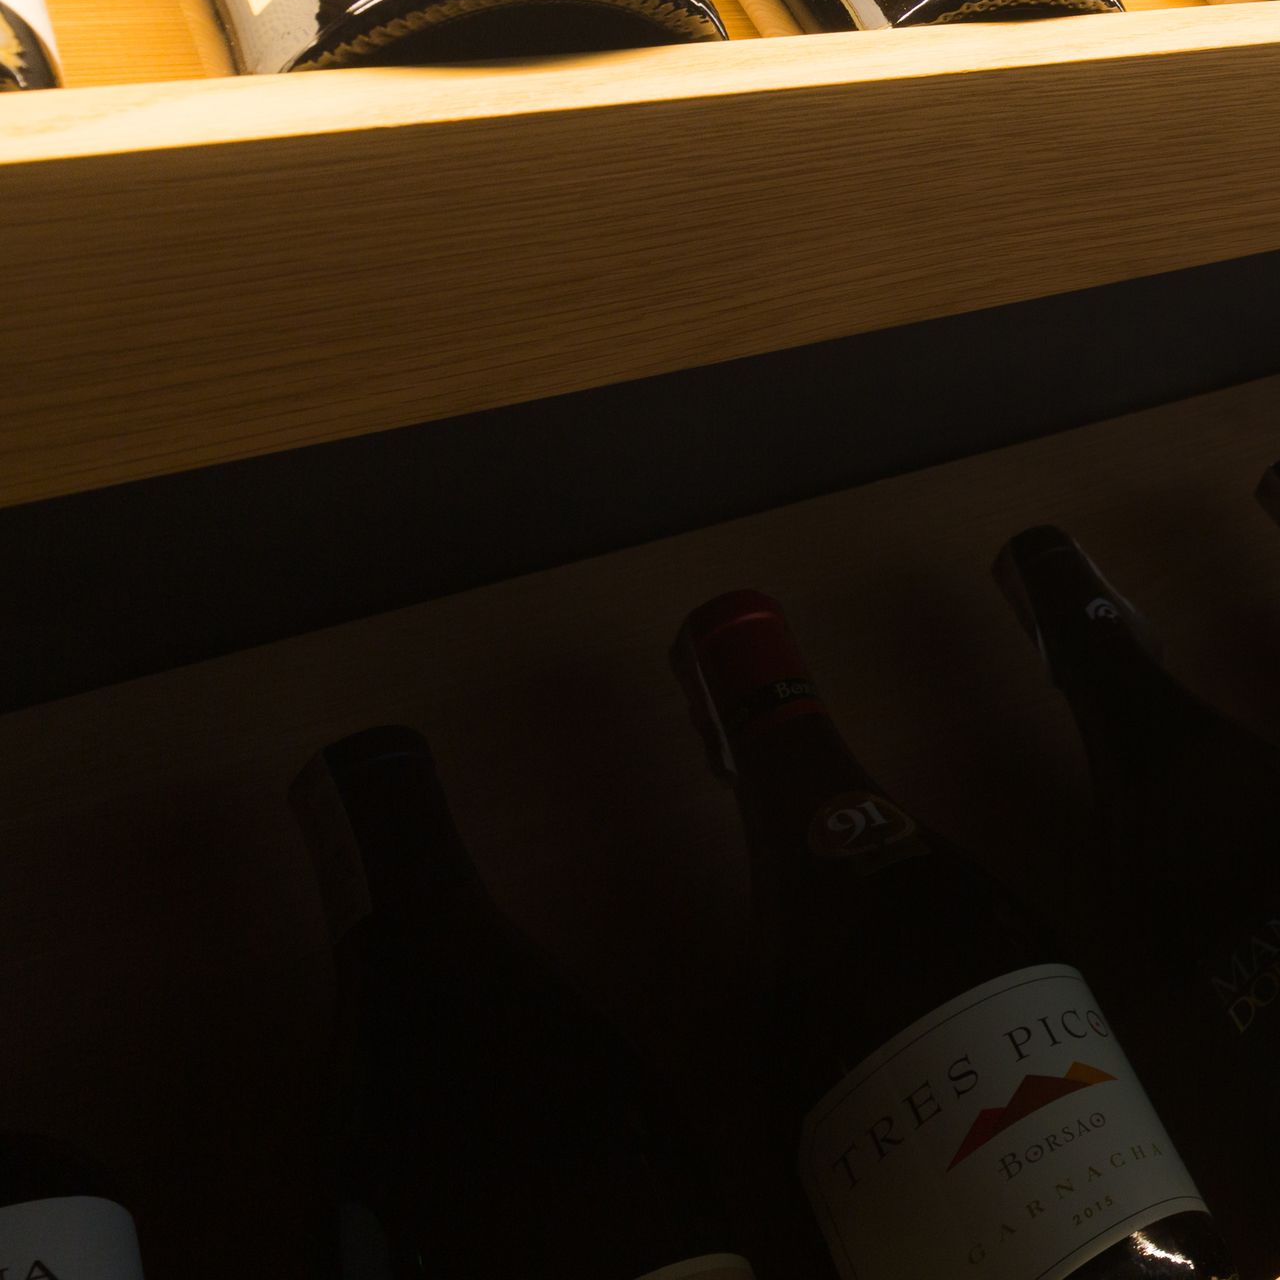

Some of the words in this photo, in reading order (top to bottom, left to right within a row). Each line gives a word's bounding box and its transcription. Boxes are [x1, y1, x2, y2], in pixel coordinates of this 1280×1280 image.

[826, 799, 889, 847] 91
[831, 1052, 981, 1191] TRES
[966, 1142, 1164, 1266] GARNACHA
[1071, 1195, 1116, 1226] 2015
